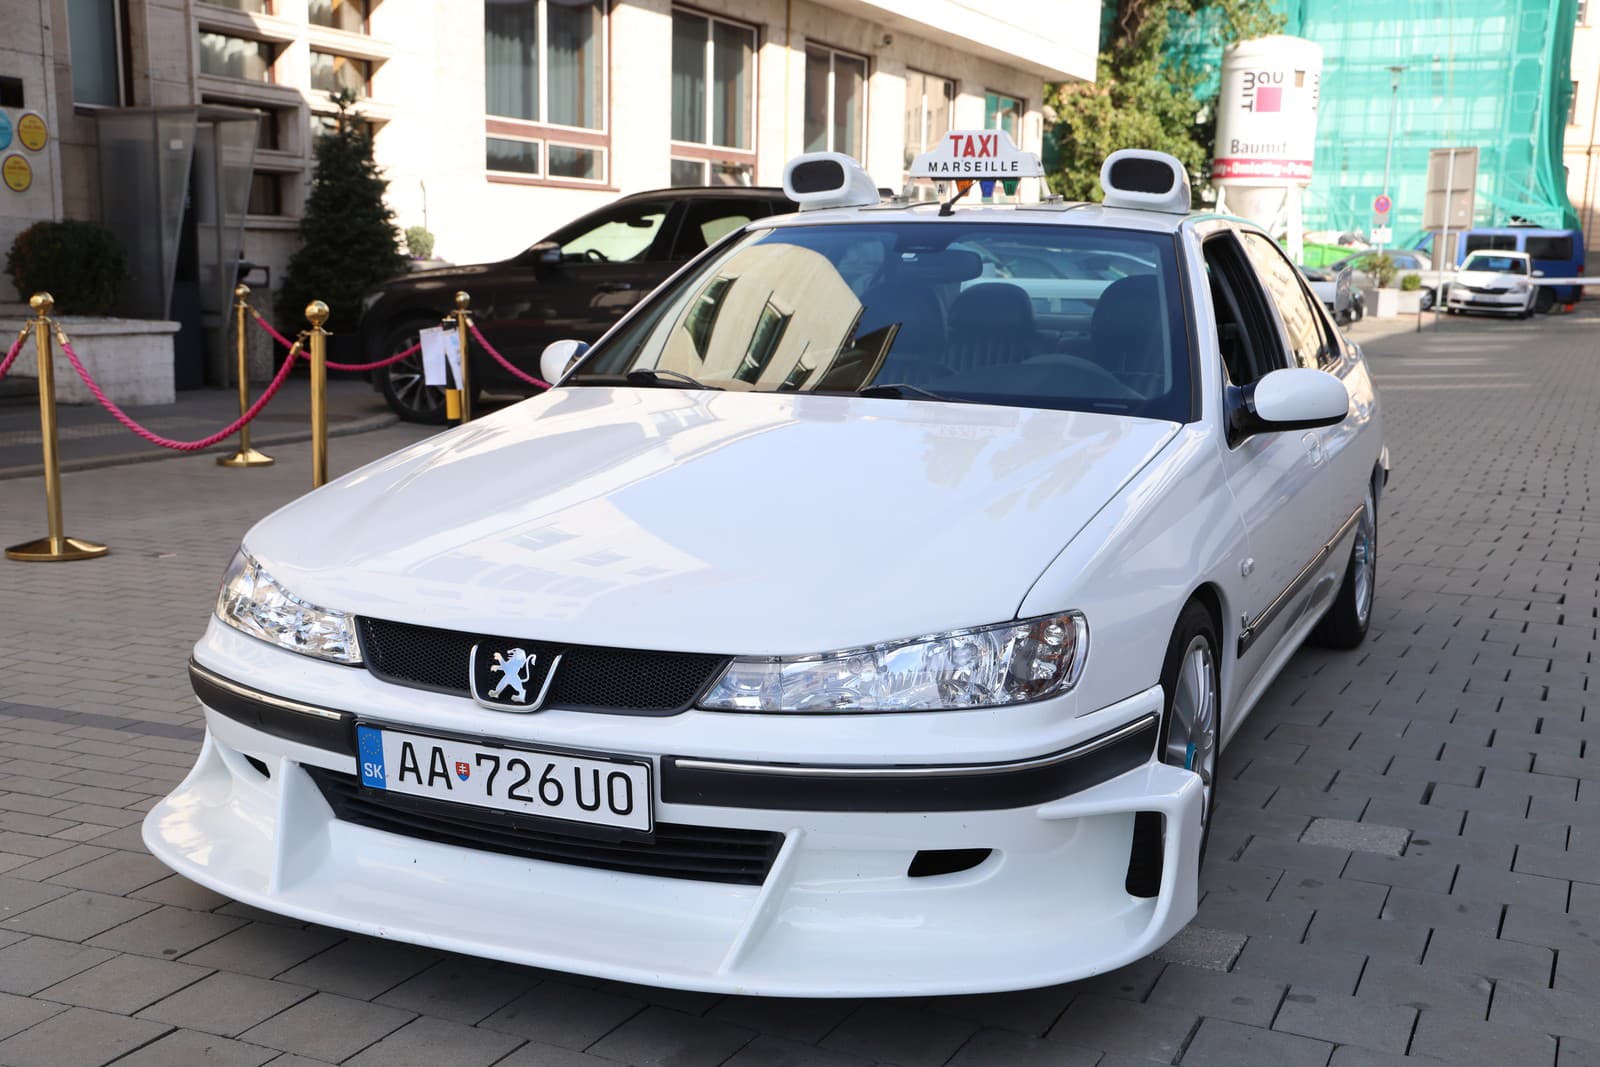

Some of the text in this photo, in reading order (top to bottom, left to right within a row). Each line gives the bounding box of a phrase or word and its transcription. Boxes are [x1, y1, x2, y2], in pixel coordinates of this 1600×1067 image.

[949, 134, 998, 158] TAXI
[1230, 139, 1287, 155] Baumit
[928, 160, 1019, 173] MARSEILLE
[364, 762, 384, 779] SK
[398, 741, 454, 791] AA
